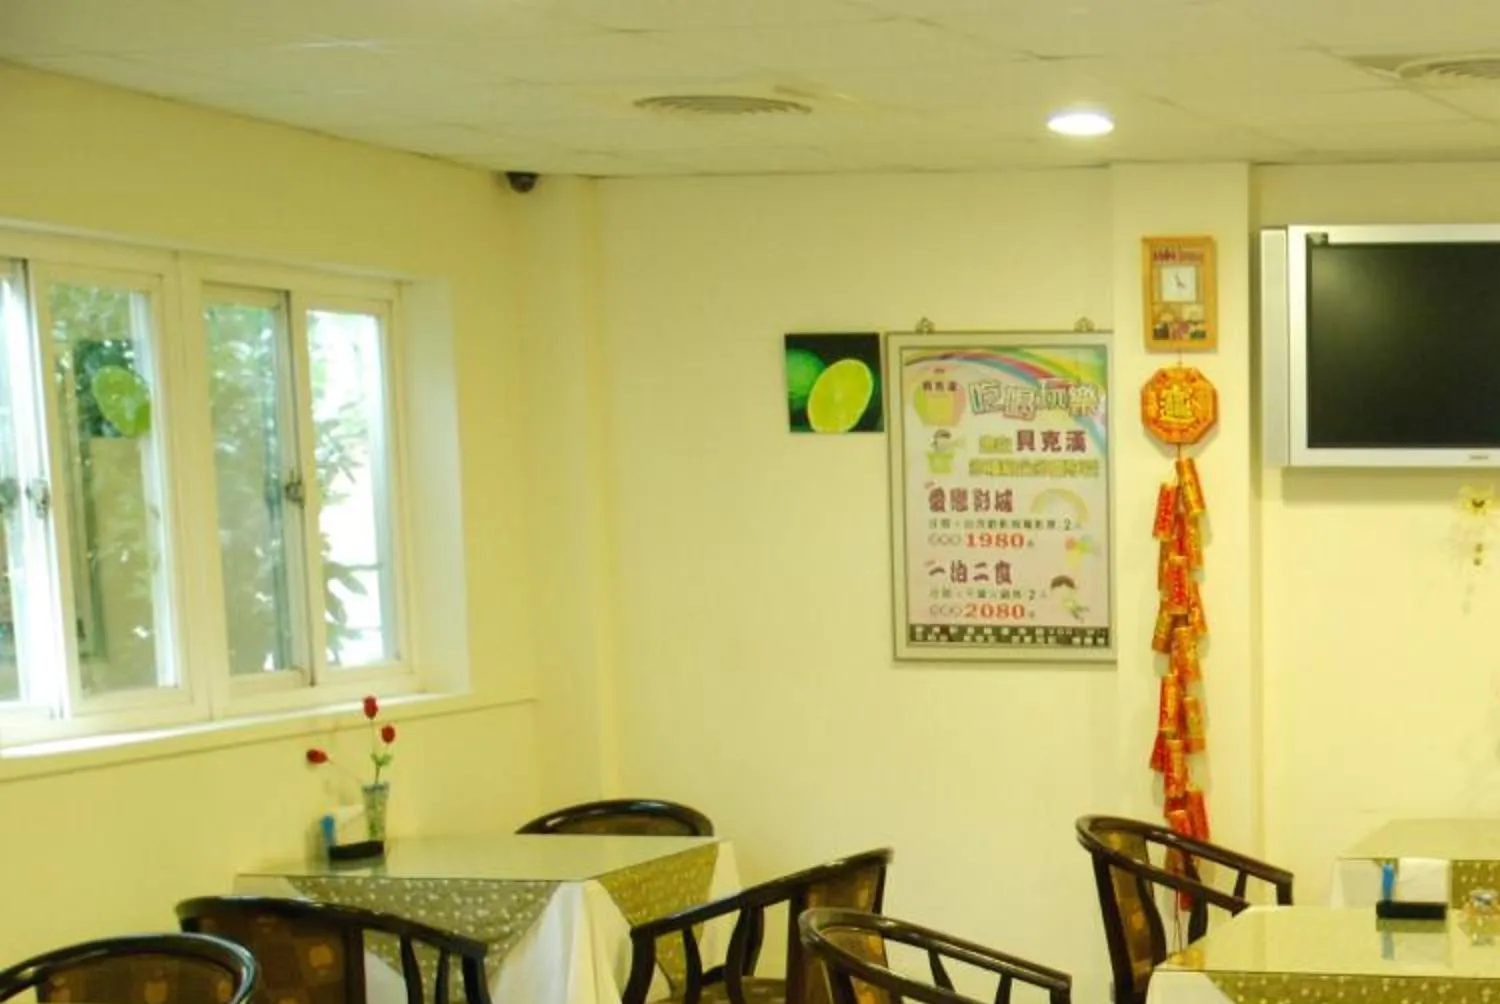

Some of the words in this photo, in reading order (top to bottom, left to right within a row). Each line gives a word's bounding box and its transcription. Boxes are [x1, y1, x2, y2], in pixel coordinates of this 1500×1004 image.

[965, 532, 1026, 549] 1980
[928, 559, 1013, 585] 一泊二食
[964, 603, 1026, 620] 2080
